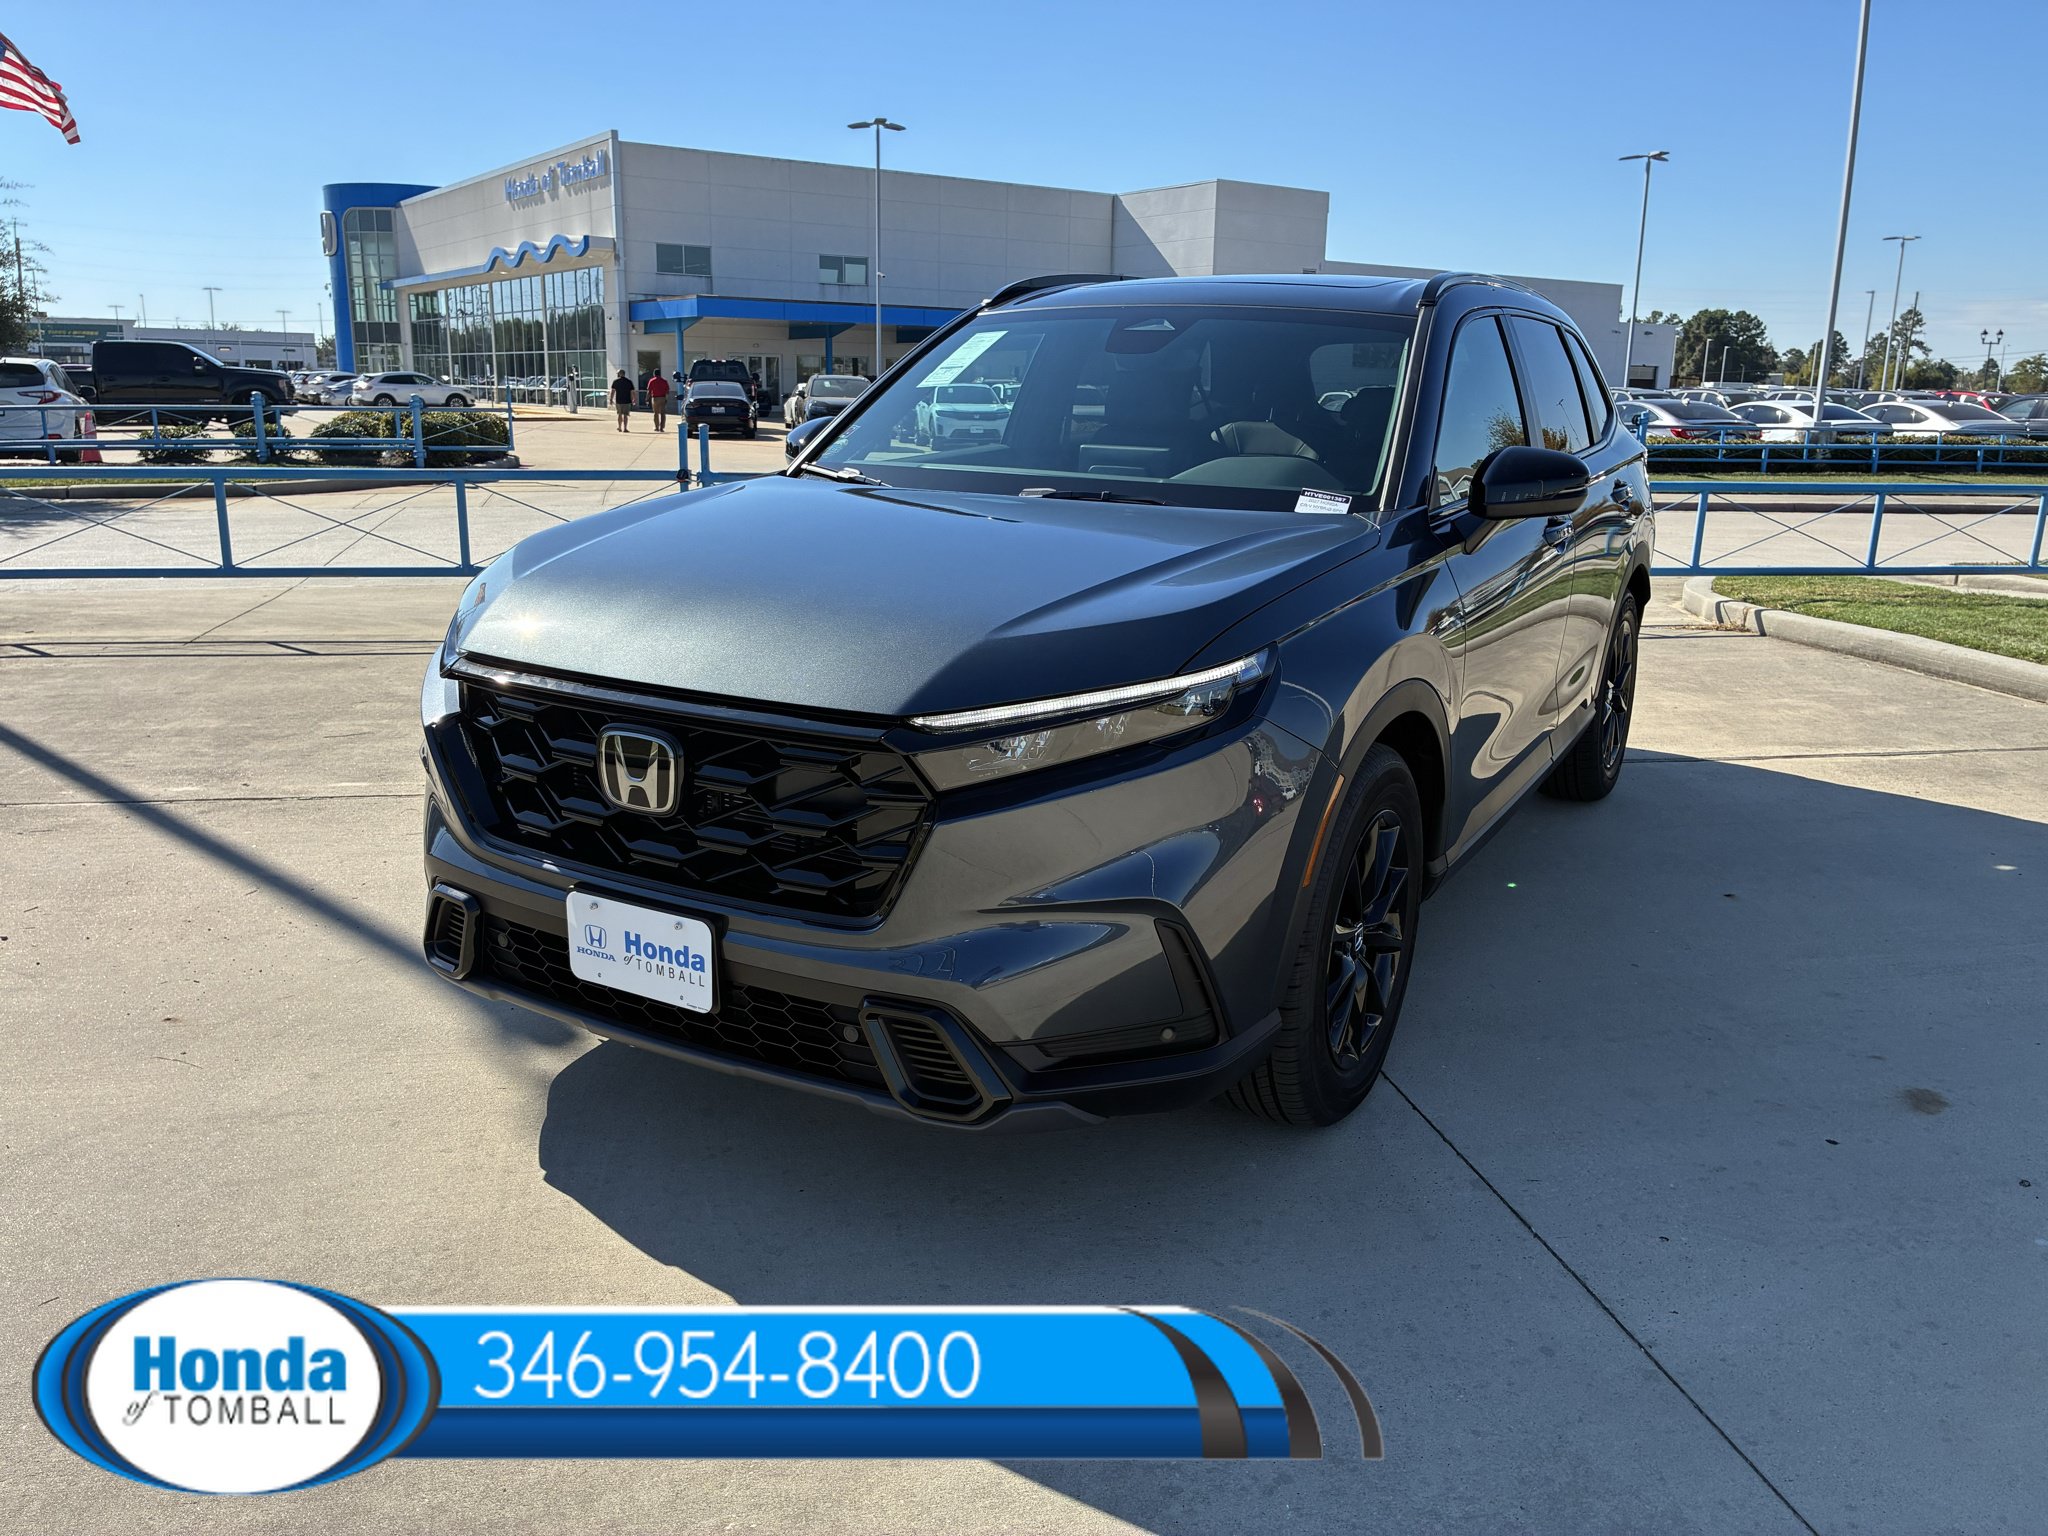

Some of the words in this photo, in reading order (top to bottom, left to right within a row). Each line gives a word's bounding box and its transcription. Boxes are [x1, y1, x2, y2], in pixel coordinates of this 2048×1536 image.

[504, 173, 538, 202] Honda
[541, 165, 553, 193] of
[557, 149, 605, 186] Tomball
[576, 945, 617, 962] HONDA
[624, 930, 706, 973] Honda
[623, 954, 635, 966] of
[636, 958, 705, 988] TOMBALL
